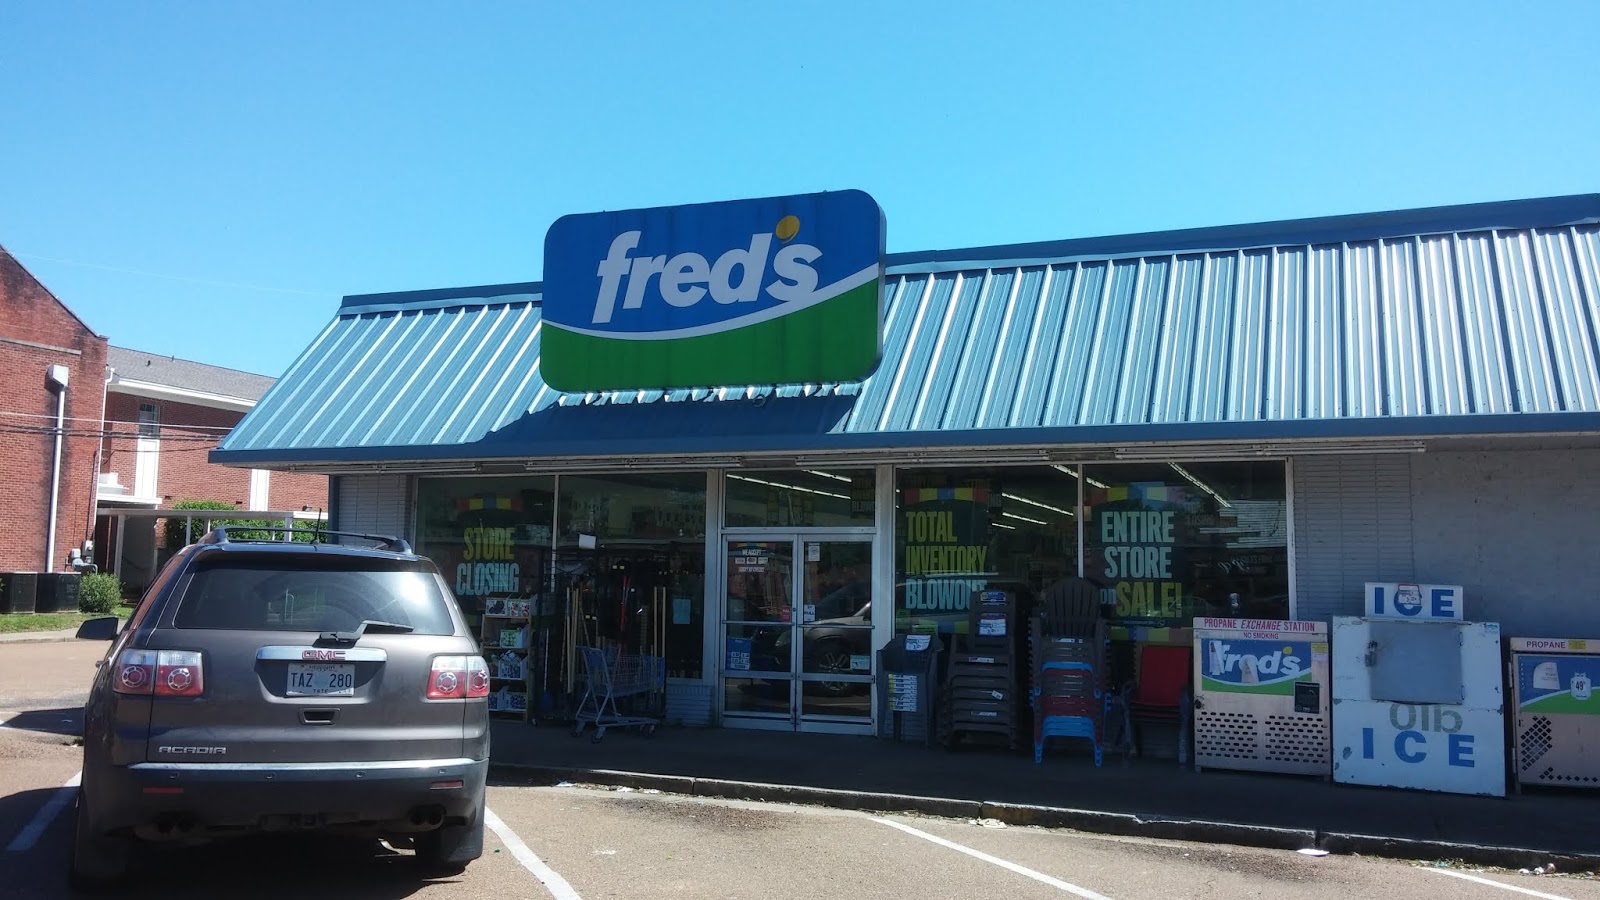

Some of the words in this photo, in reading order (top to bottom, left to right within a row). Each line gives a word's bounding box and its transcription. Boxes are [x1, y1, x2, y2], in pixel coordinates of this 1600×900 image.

[591, 215, 823, 324] fred's
[905, 511, 957, 543] TOTAL
[1101, 511, 1175, 543] ENTIRE
[463, 527, 517, 560] STORE
[905, 545, 988, 575] INVENTORY
[1104, 546, 1172, 579] STORE
[456, 562, 520, 596] CLOSING
[1116, 581, 1183, 618] SALE!
[1374, 586, 1455, 618] ICE
[1204, 618, 1237, 629] PROPANE
[1241, 619, 1282, 631] EXCHANGE
[1283, 621, 1315, 632] STATION
[1253, 632, 1279, 640] SMOKING
[302, 650, 346, 660] GMC
[1526, 640, 1566, 649] PROPANE
[291, 672, 314, 688] TAZ
[329, 673, 352, 688] 280
[159, 746, 226, 754] ACADIA
[1363, 728, 1475, 768] ICE
